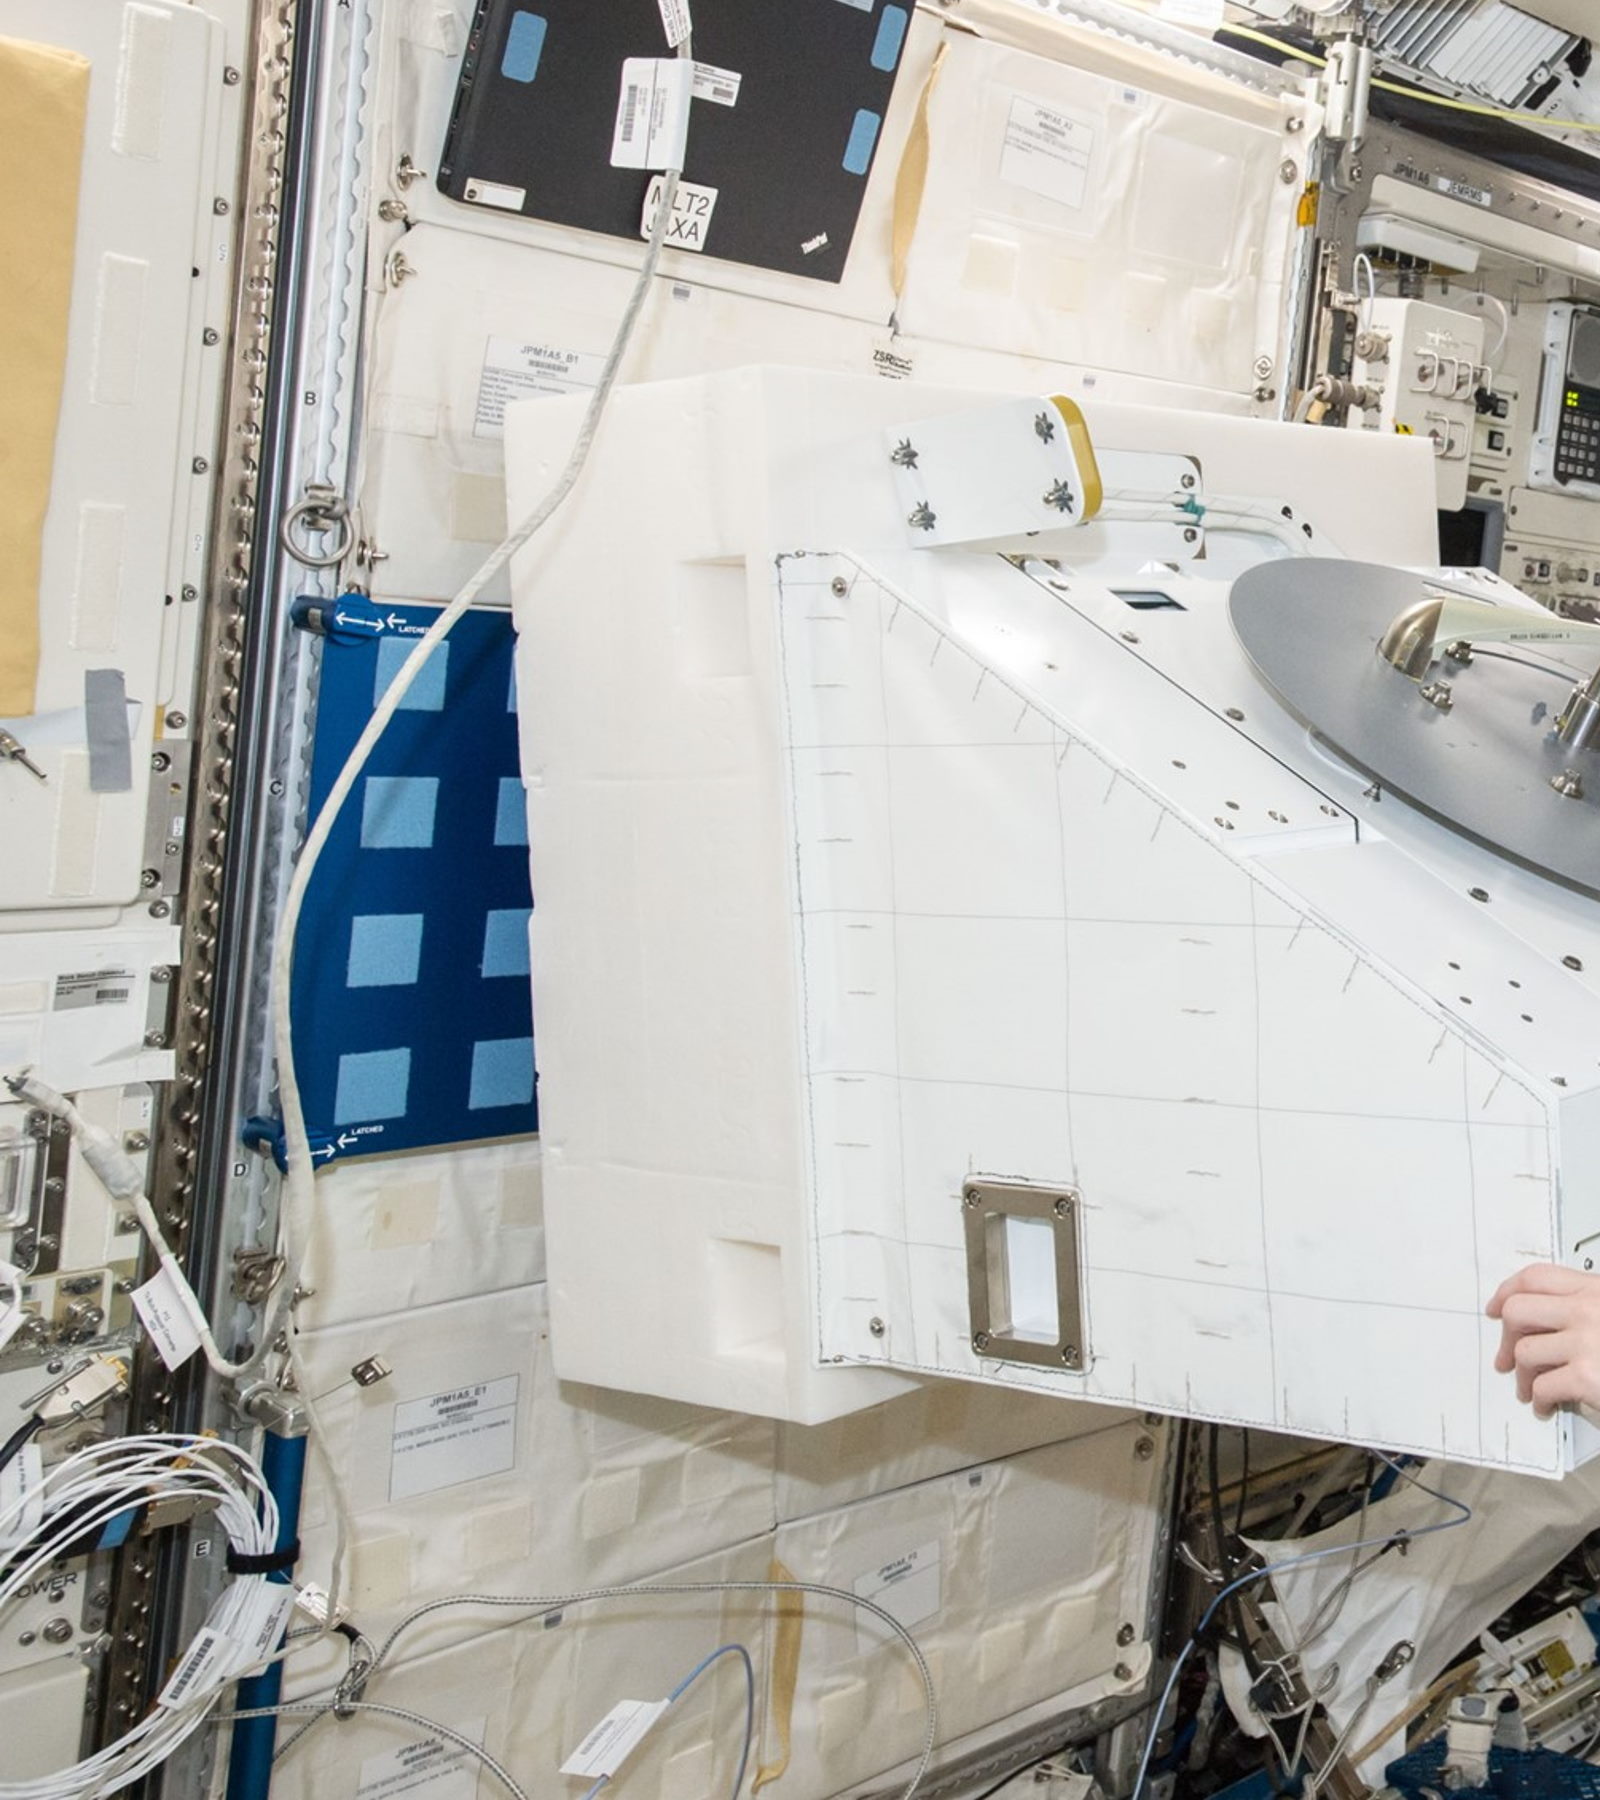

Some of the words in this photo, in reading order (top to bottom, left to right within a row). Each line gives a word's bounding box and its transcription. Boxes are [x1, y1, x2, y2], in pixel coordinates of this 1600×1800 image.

[646, 212, 699, 242] JXA
[303, 392, 316, 405] B
[270, 780, 282, 795] C
[233, 1163, 246, 1177] D
[195, 1541, 208, 1556] E
[11, 1572, 77, 1599] OWER
